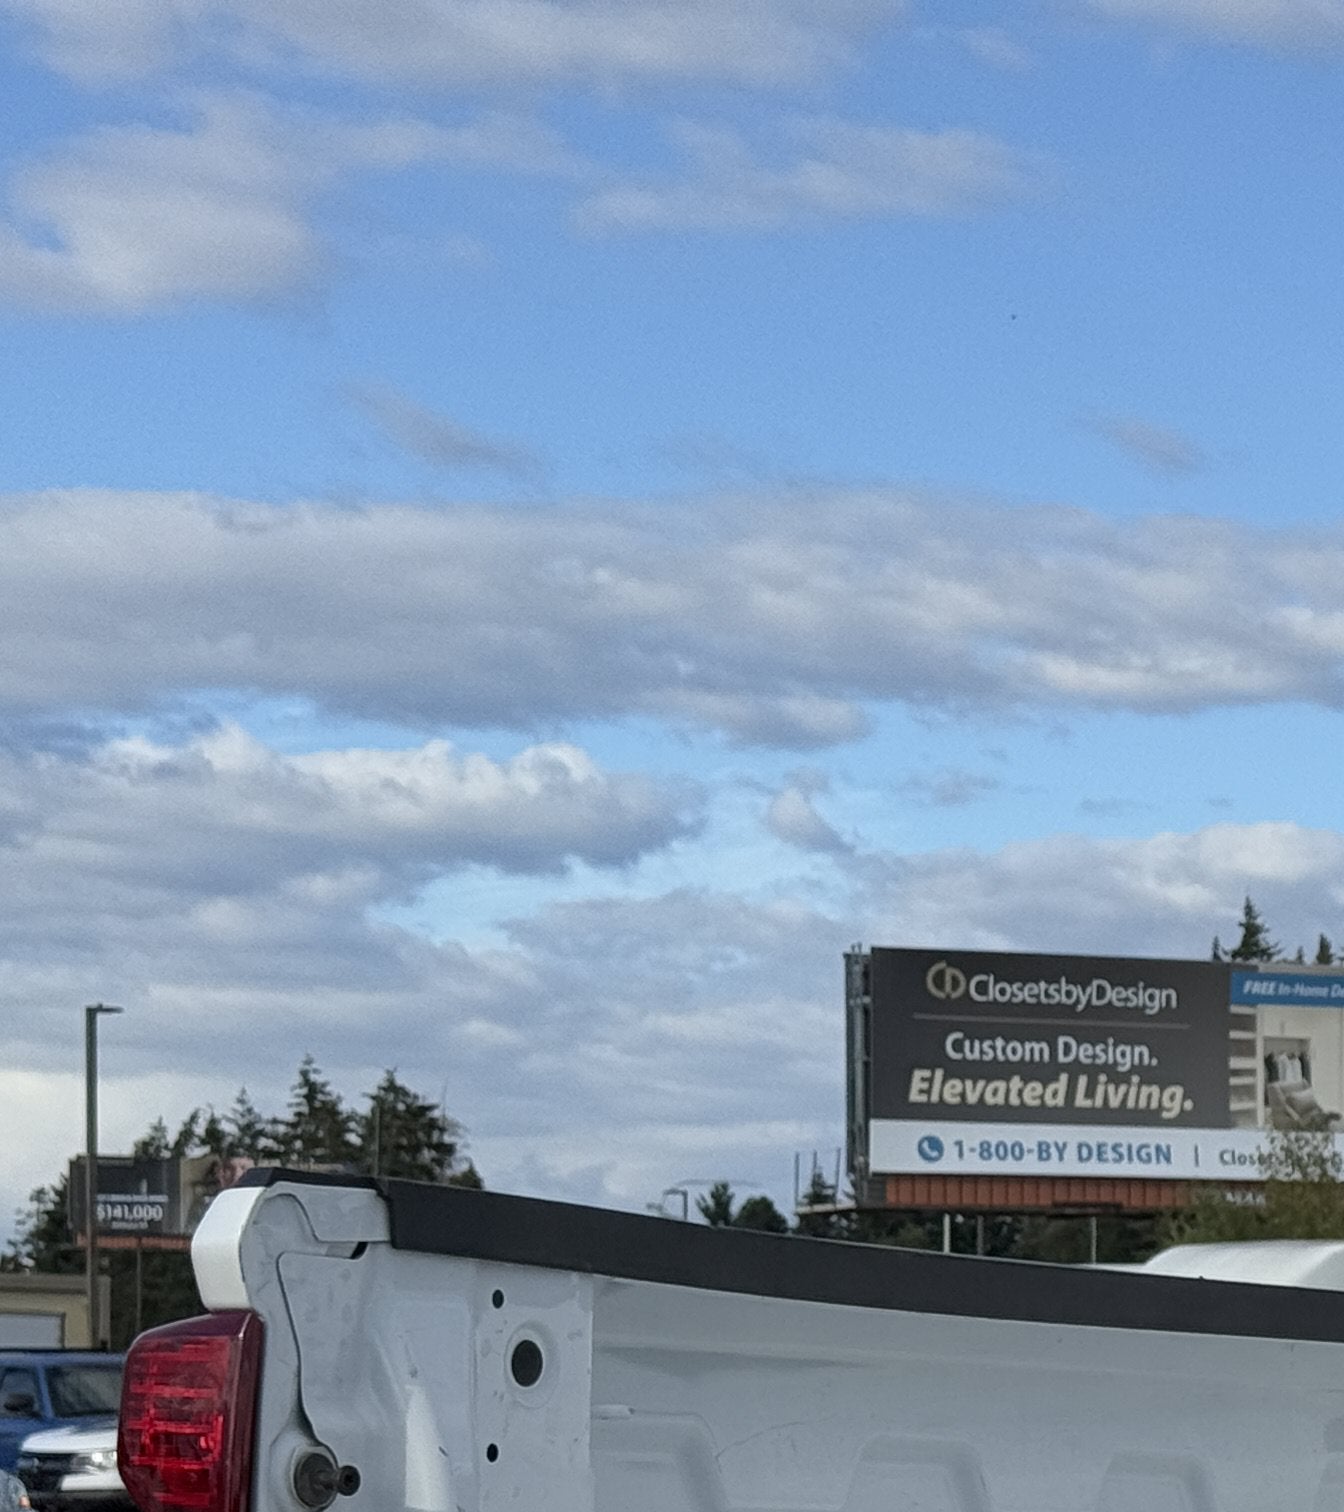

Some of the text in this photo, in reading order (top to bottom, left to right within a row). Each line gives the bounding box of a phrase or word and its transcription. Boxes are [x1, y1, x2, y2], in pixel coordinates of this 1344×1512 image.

[969, 973, 1178, 1015] ClosetsbyDesign
[1243, 979, 1275, 996] FREE
[945, 1031, 1159, 1071] Custom Design.
[908, 1067, 1195, 1119] Elevated Living.
[953, 1139, 1173, 1165] 1-800-BY DESIGN
